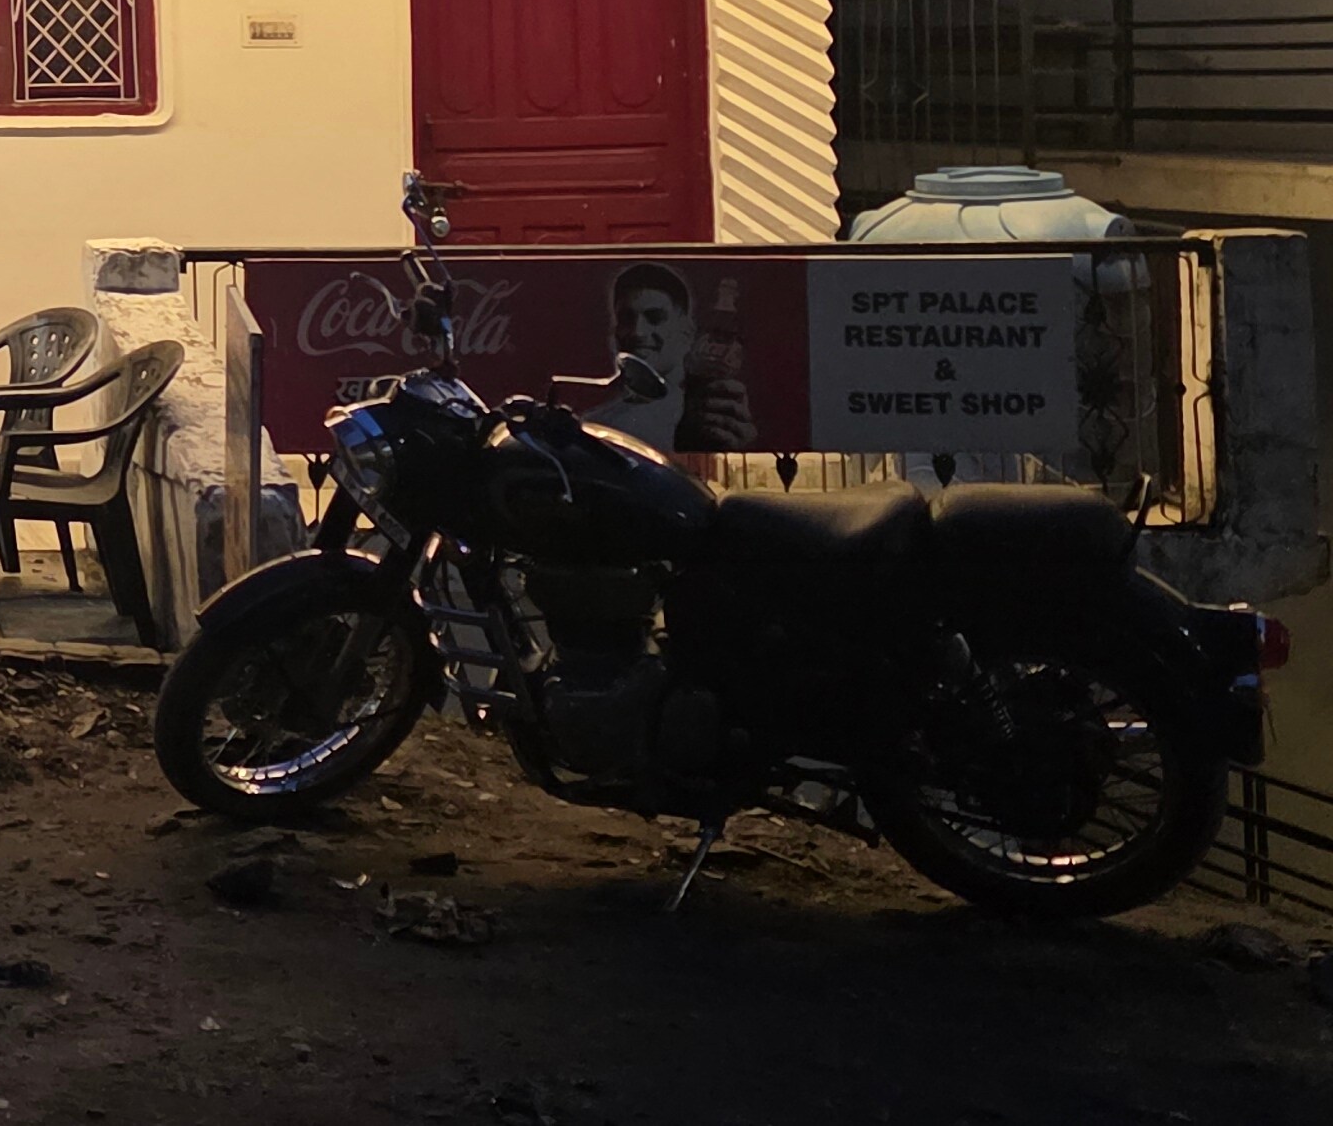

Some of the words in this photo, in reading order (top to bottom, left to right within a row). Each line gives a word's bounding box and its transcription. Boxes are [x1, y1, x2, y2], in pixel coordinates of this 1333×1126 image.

[852, 290, 909, 314] SPT
[920, 291, 1039, 315] PALACE
[297, 278, 523, 357] CocaCola
[844, 324, 1047, 347] RESTAURANT
[935, 359, 957, 381] &
[847, 391, 953, 416] SWEET
[962, 390, 1047, 415] SHOP
